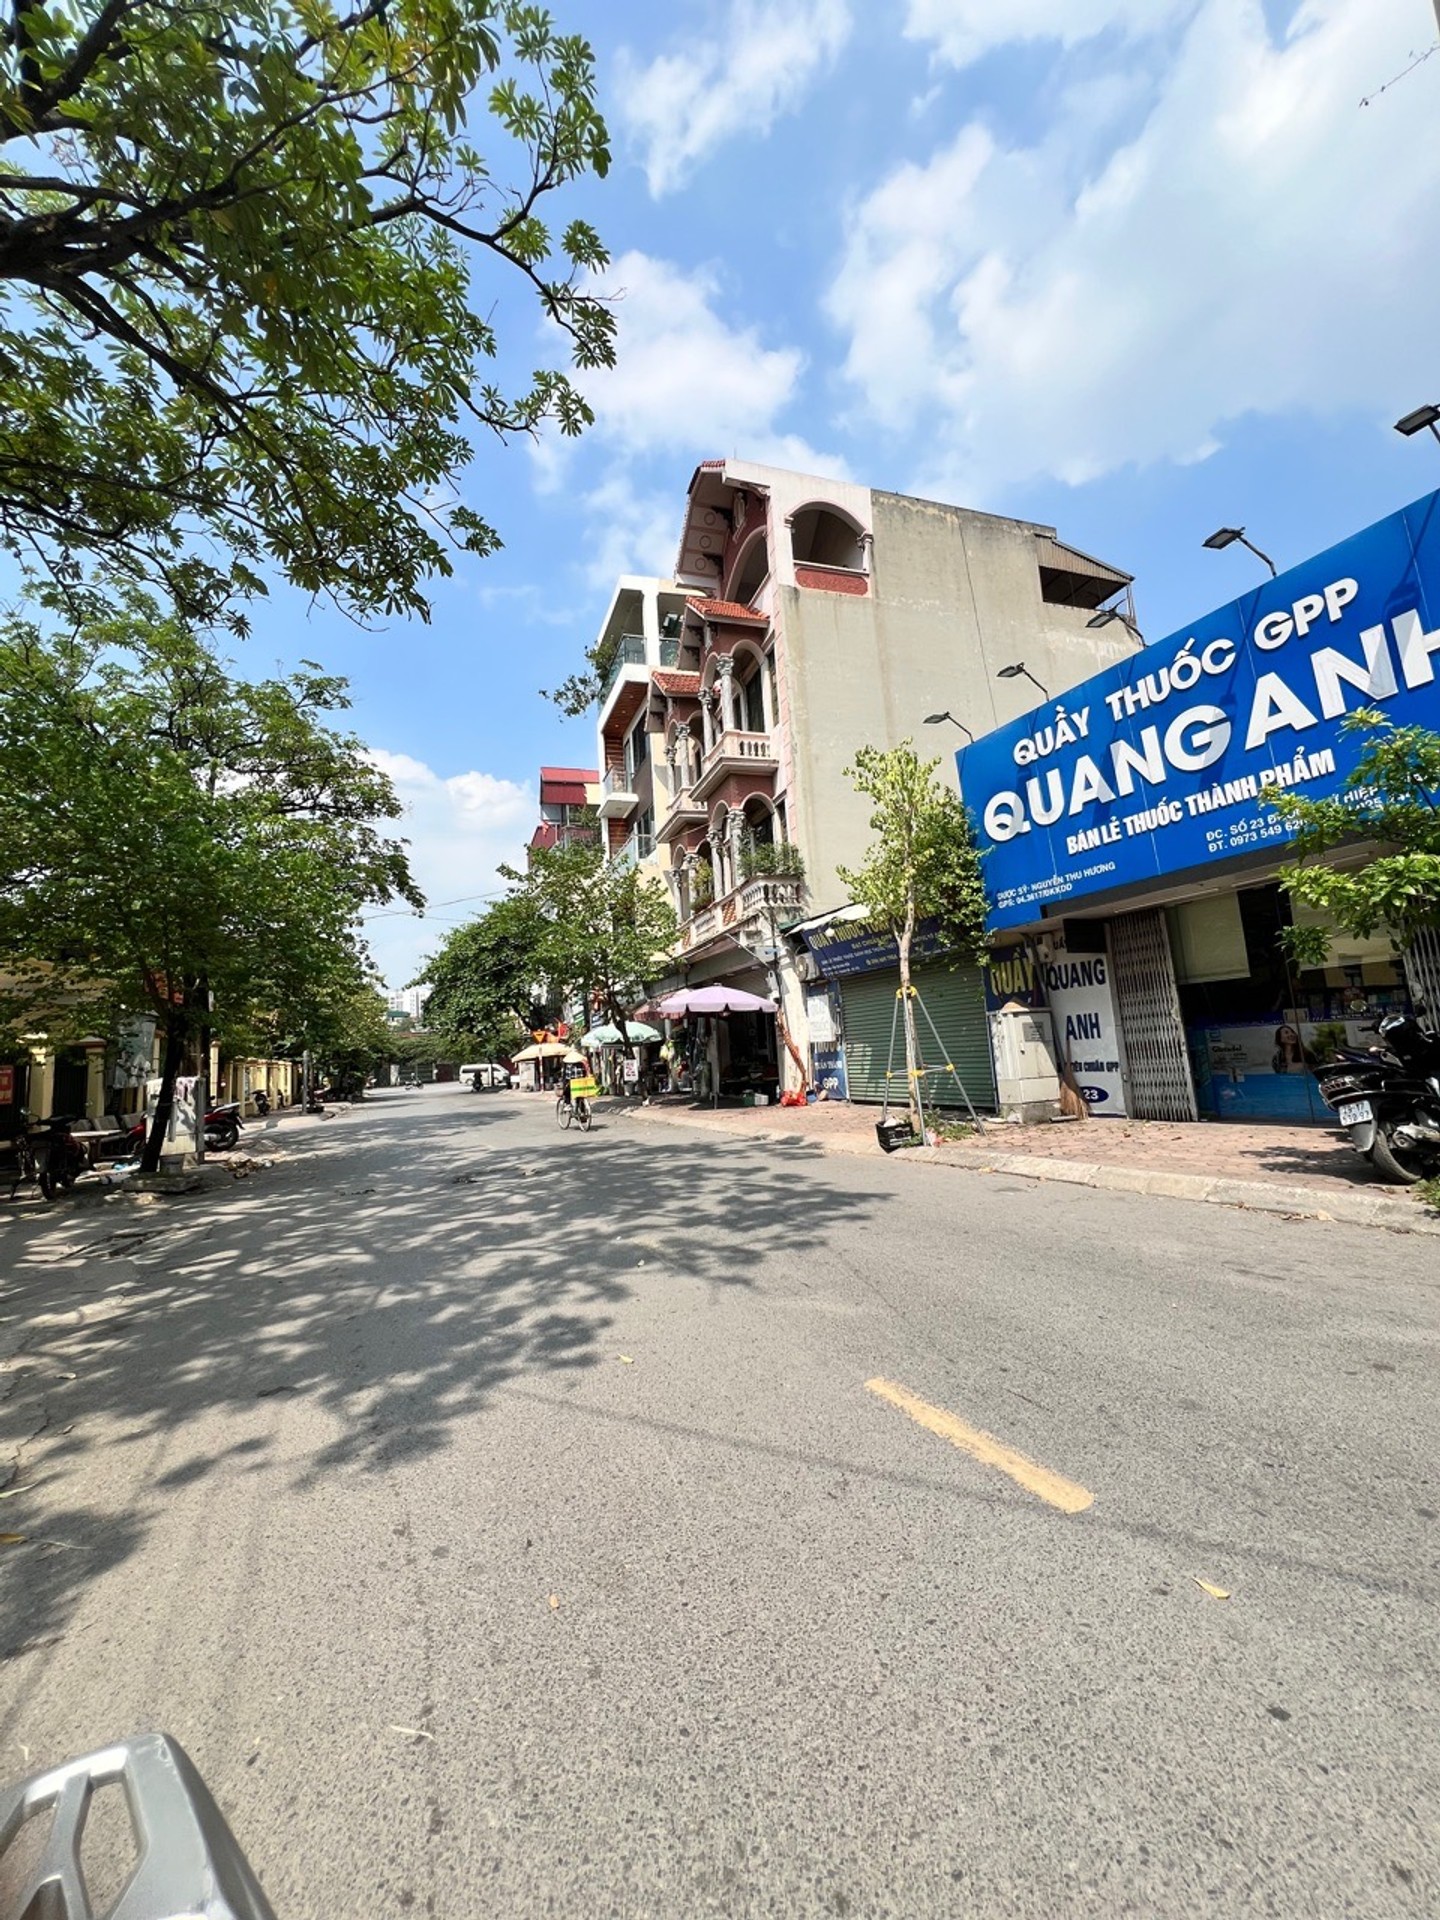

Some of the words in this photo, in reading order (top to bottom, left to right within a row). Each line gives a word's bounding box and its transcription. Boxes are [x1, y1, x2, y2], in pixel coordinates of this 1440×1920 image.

[1014, 705, 1090, 766] QUẦY
[1105, 637, 1236, 722] THUỐC
[1253, 577, 1359, 650] GPP
[984, 704, 1232, 842] QUANG
[1066, 826, 1101, 856] BÁN
[1101, 815, 1123, 843] LẺ
[1123, 795, 1184, 836] THUỐC
[1184, 783, 1258, 817] THÀNH
[1259, 745, 1336, 790] PHẨM
[1229, 817, 1248, 835] SỐ
[1249, 817, 1265, 830] 23
[1230, 831, 1258, 847] 0973
[1260, 825, 1282, 838] 549
[1065, 872, 1083, 882] THU
[1083, 861, 1116, 878] HƯƠNG
[1048, 958, 1106, 991] QUANG
[1066, 1012, 1101, 1040] ANH
